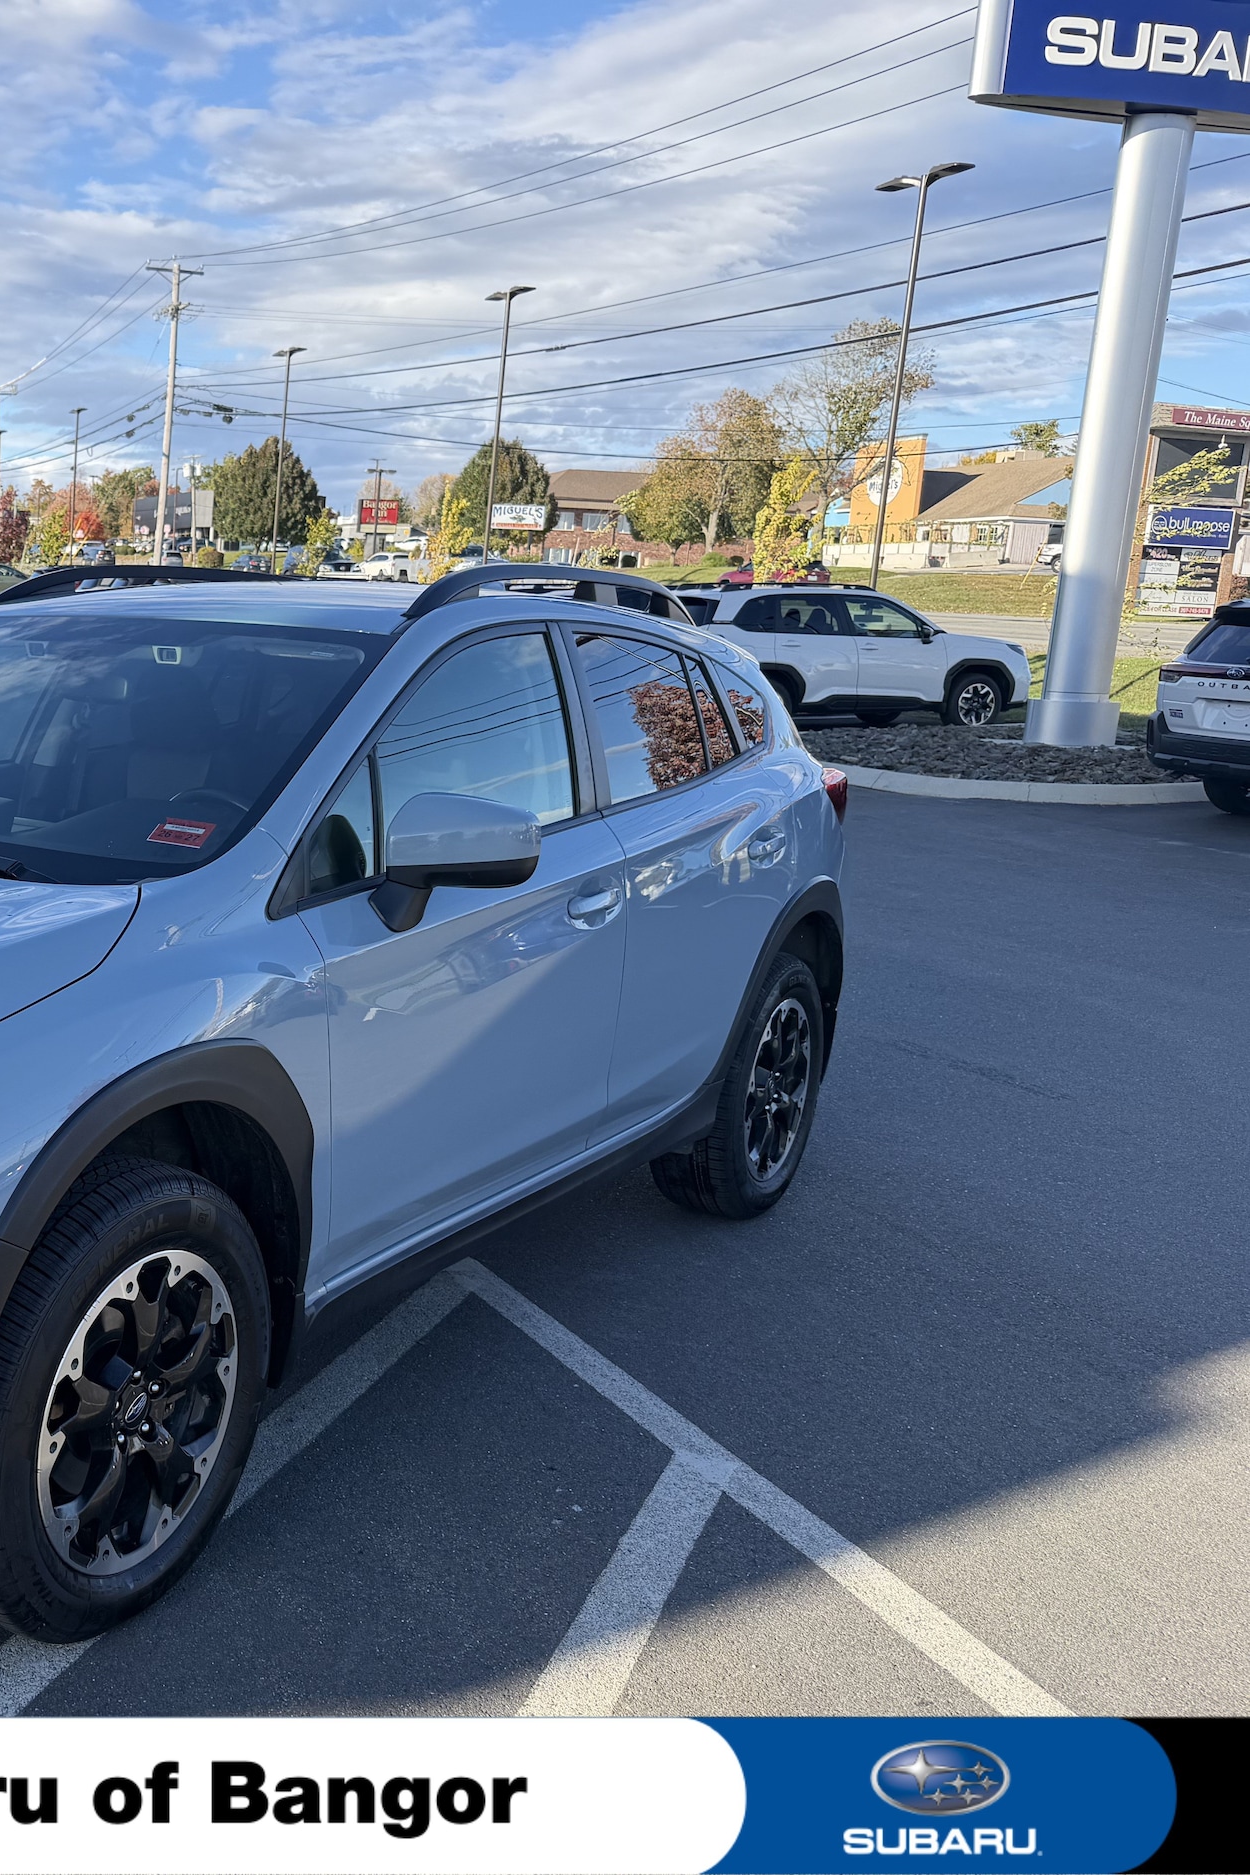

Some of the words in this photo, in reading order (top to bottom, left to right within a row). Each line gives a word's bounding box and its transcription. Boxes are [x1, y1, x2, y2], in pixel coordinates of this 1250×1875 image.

[1044, 15, 1250, 83] SUBA
[1184, 411, 1203, 424] The
[1205, 413, 1237, 427] Maine
[493, 506, 543, 519] MIGUEL'S
[1168, 515, 1190, 532] bull
[1192, 520, 1230, 533] moose
[1181, 595, 1209, 603] SALON
[70, 1213, 170, 1309] GENERAL
